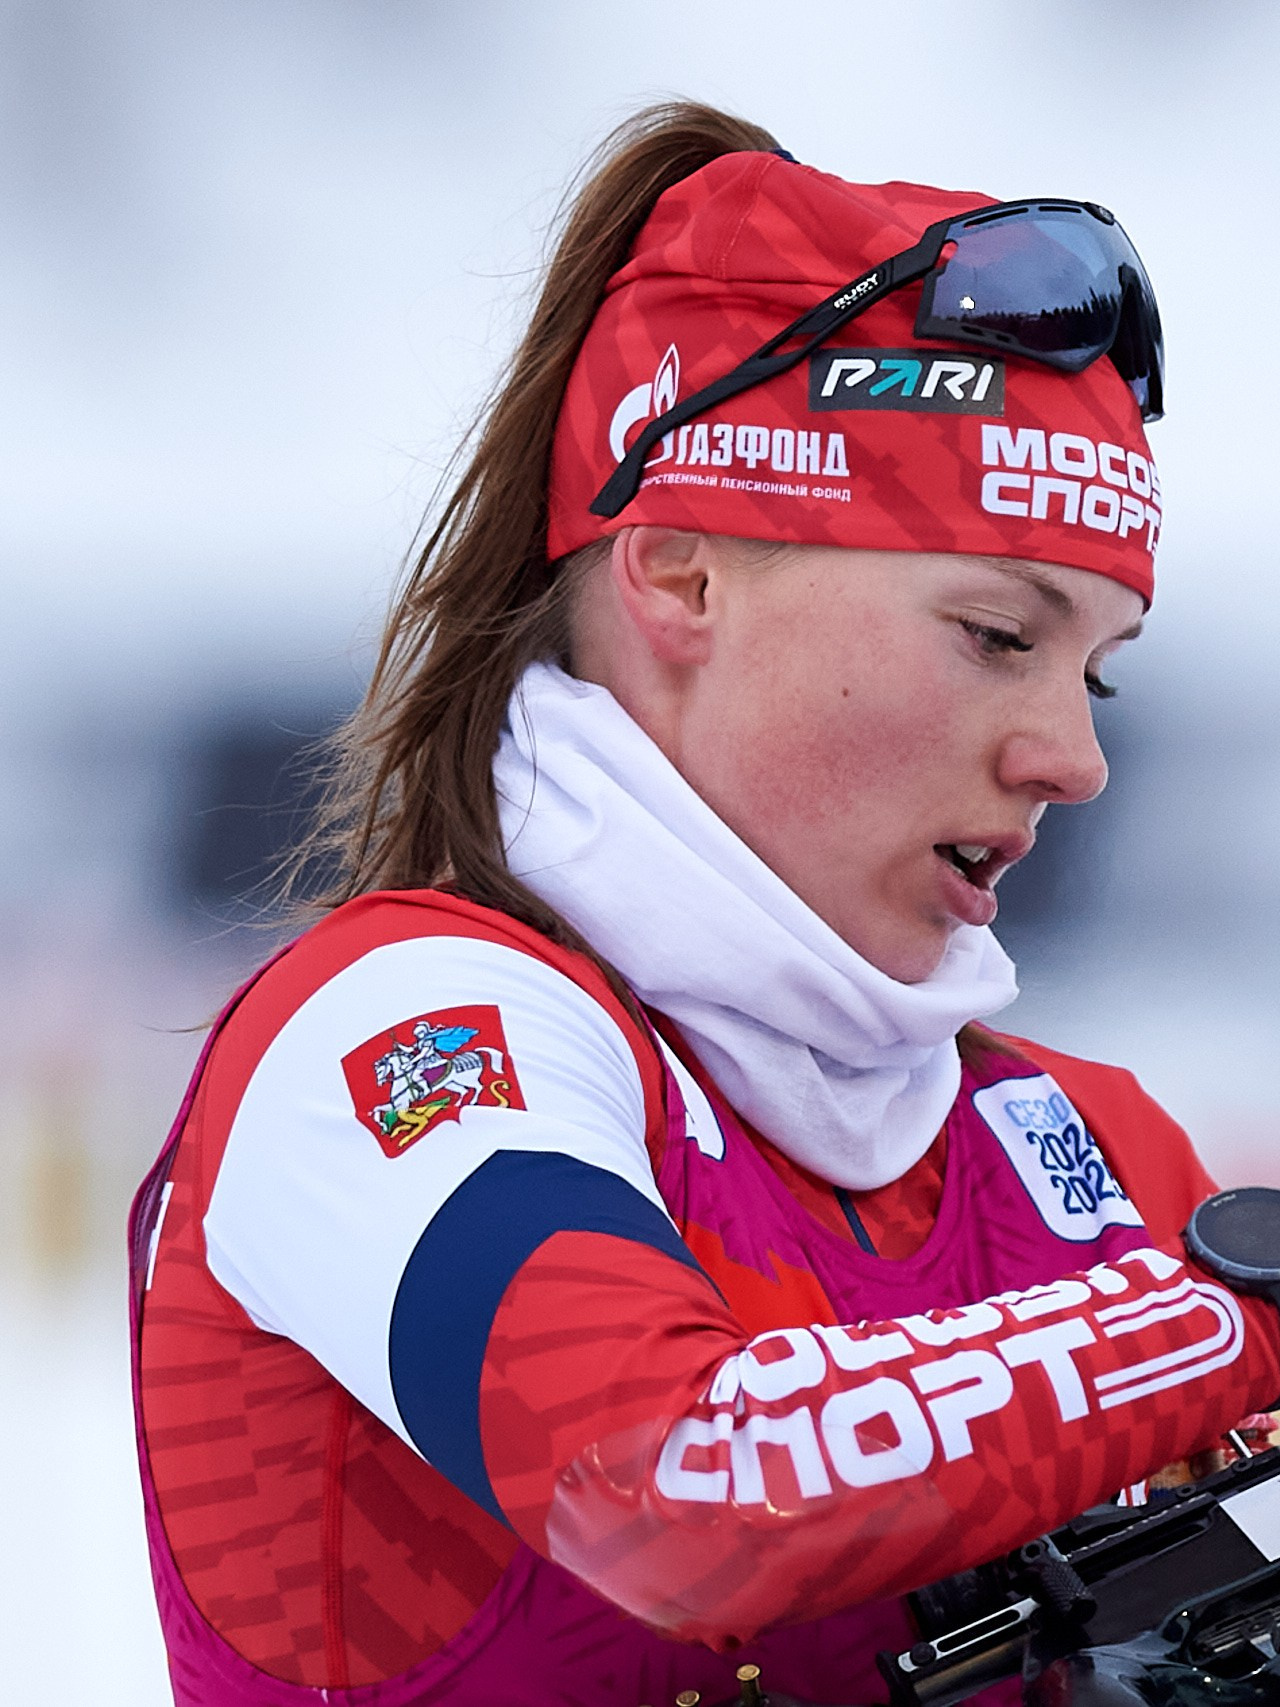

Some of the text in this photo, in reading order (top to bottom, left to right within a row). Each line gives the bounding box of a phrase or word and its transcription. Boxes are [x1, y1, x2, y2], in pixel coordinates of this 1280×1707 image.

[833, 273, 878, 309] RUDY
[820, 358, 995, 402] PARI
[674, 423, 850, 477] ГАЗФОНД
[720, 476, 808, 498] ПЕНСИОННЫЙ
[811, 486, 852, 503] ФОНД
[981, 471, 1161, 553] СПОРТ
[1025, 1122, 1098, 1172] 202
[654, 1316, 1097, 1505] СПОРТ
